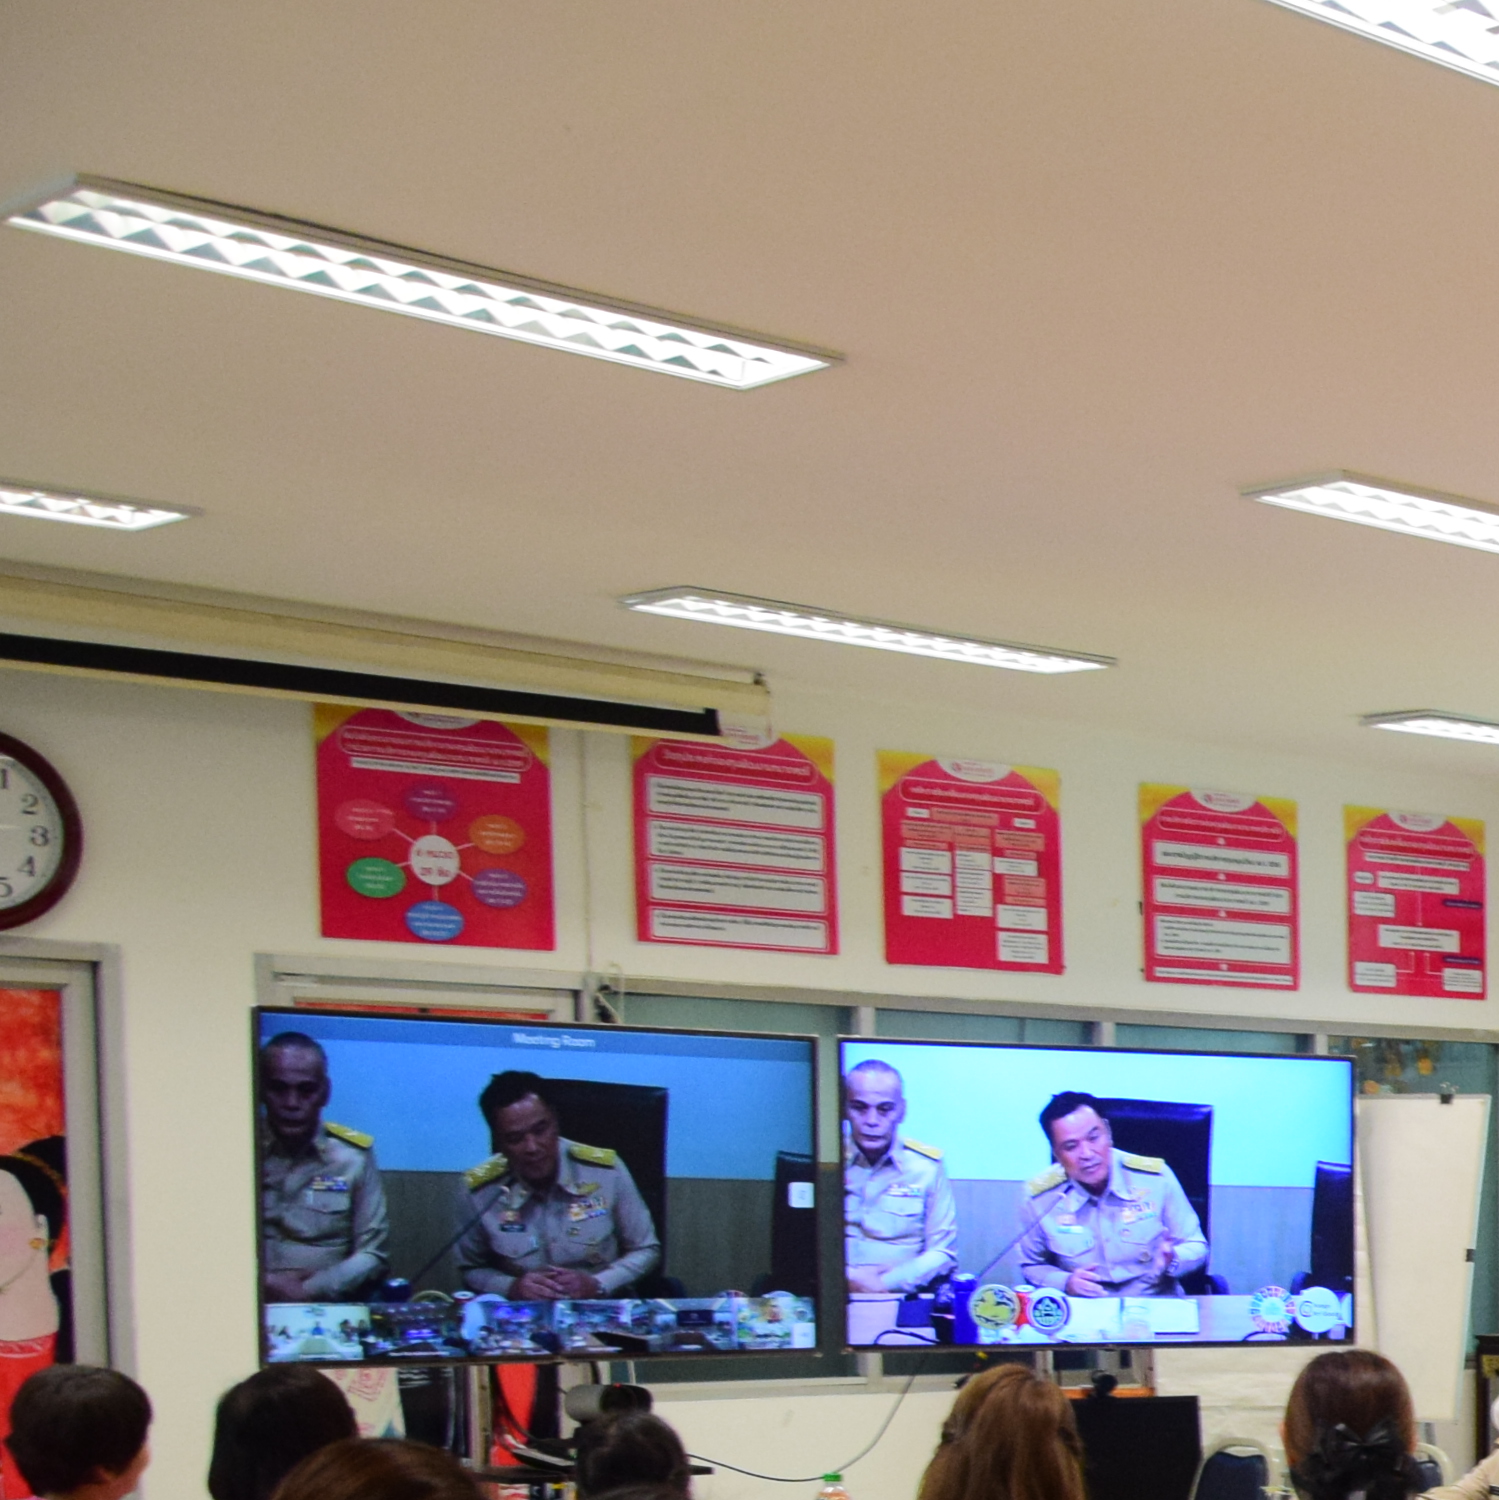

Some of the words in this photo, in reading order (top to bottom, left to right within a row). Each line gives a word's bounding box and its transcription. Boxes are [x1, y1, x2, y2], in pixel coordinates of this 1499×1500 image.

[21, 793, 38, 815] 2
[31, 825, 49, 847] 3
[18, 855, 35, 877] 4
[512, 1032, 561, 1048] Meeting
[561, 1034, 596, 1048] Room
